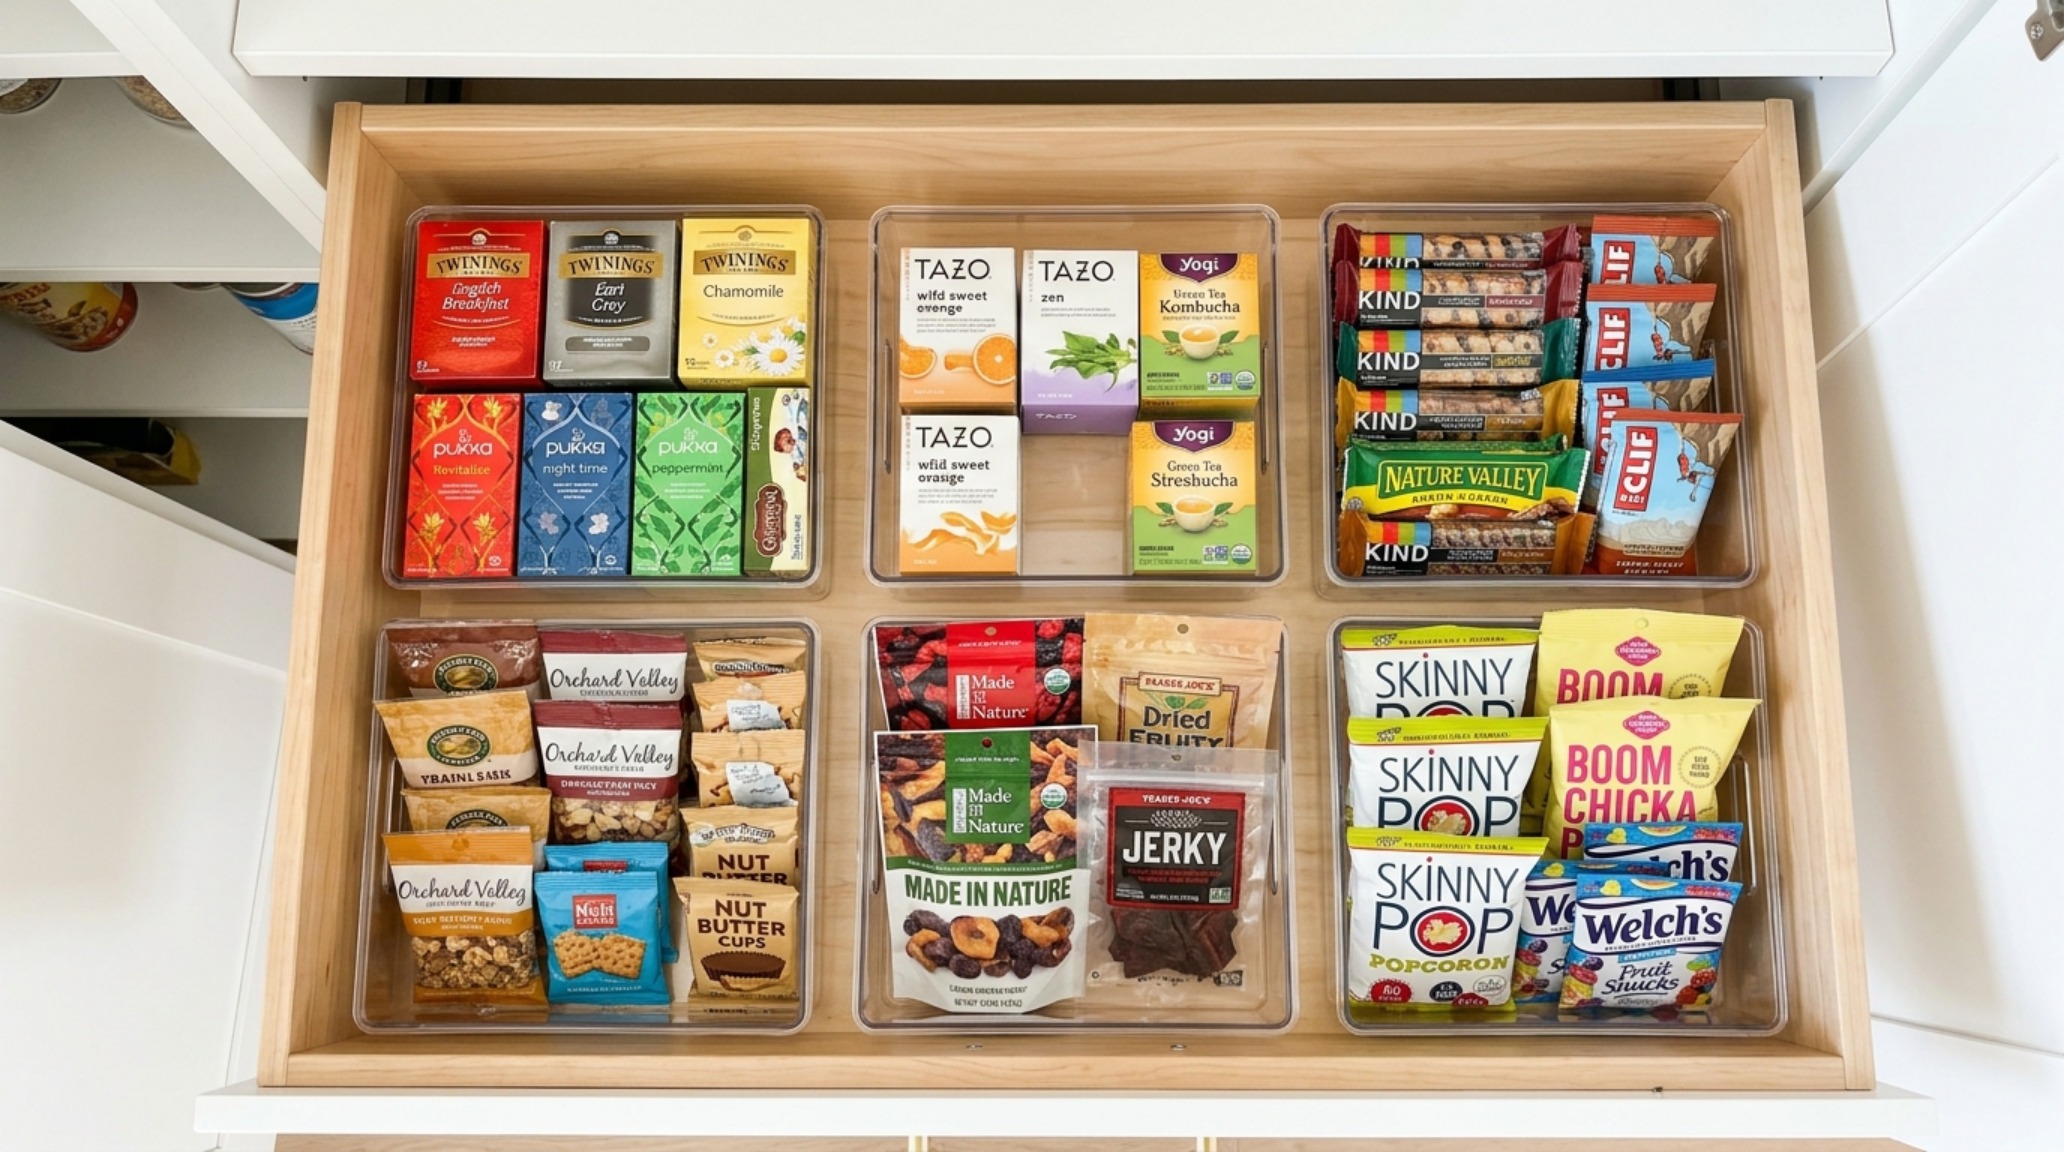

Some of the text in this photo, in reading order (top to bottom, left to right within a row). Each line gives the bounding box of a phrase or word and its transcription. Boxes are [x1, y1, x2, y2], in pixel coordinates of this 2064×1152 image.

[436, 256, 523, 275] TWININGS
[568, 256, 655, 275] TWININGS
[700, 252, 789, 272] TWININGS
[914, 258, 992, 280] TAZO
[1038, 260, 1115, 282] TAZO
[1604, 245, 1630, 284] LIF
[703, 284, 784, 298] Chamomile
[1041, 293, 1065, 303] zen
[1358, 290, 1421, 310] KIND
[1159, 299, 1241, 314] Kombucha
[1357, 351, 1420, 371] KIND
[1354, 411, 1417, 431] KIND
[915, 426, 993, 448] TAZO
[579, 463, 608, 474] time
[951, 459, 990, 470] sweet
[1622, 431, 1653, 495] CLIF
[1385, 465, 1542, 496] NATURE VALLEY
[1365, 543, 1429, 563] KIND
[550, 667, 623, 689] Orchard
[972, 674, 1015, 690] Made
[1557, 668, 1663, 704] BOOM
[1143, 706, 1211, 730] Dried
[1566, 744, 1672, 785] BOOM
[969, 787, 1012, 803] Made
[1564, 787, 1697, 825] CHICKA
[969, 818, 1025, 834] Nature
[1378, 795, 1519, 838] POP
[1122, 830, 1227, 865] JERKY
[717, 854, 770, 871] NUT
[399, 877, 473, 899] Orchard
[904, 873, 1072, 907] MADE IN NATURE
[715, 899, 767, 918] NUT
[697, 919, 786, 936] BUTTER
[1373, 901, 1514, 957] POP
[1582, 905, 1723, 945] Welch's
[718, 935, 766, 949] CUPS
